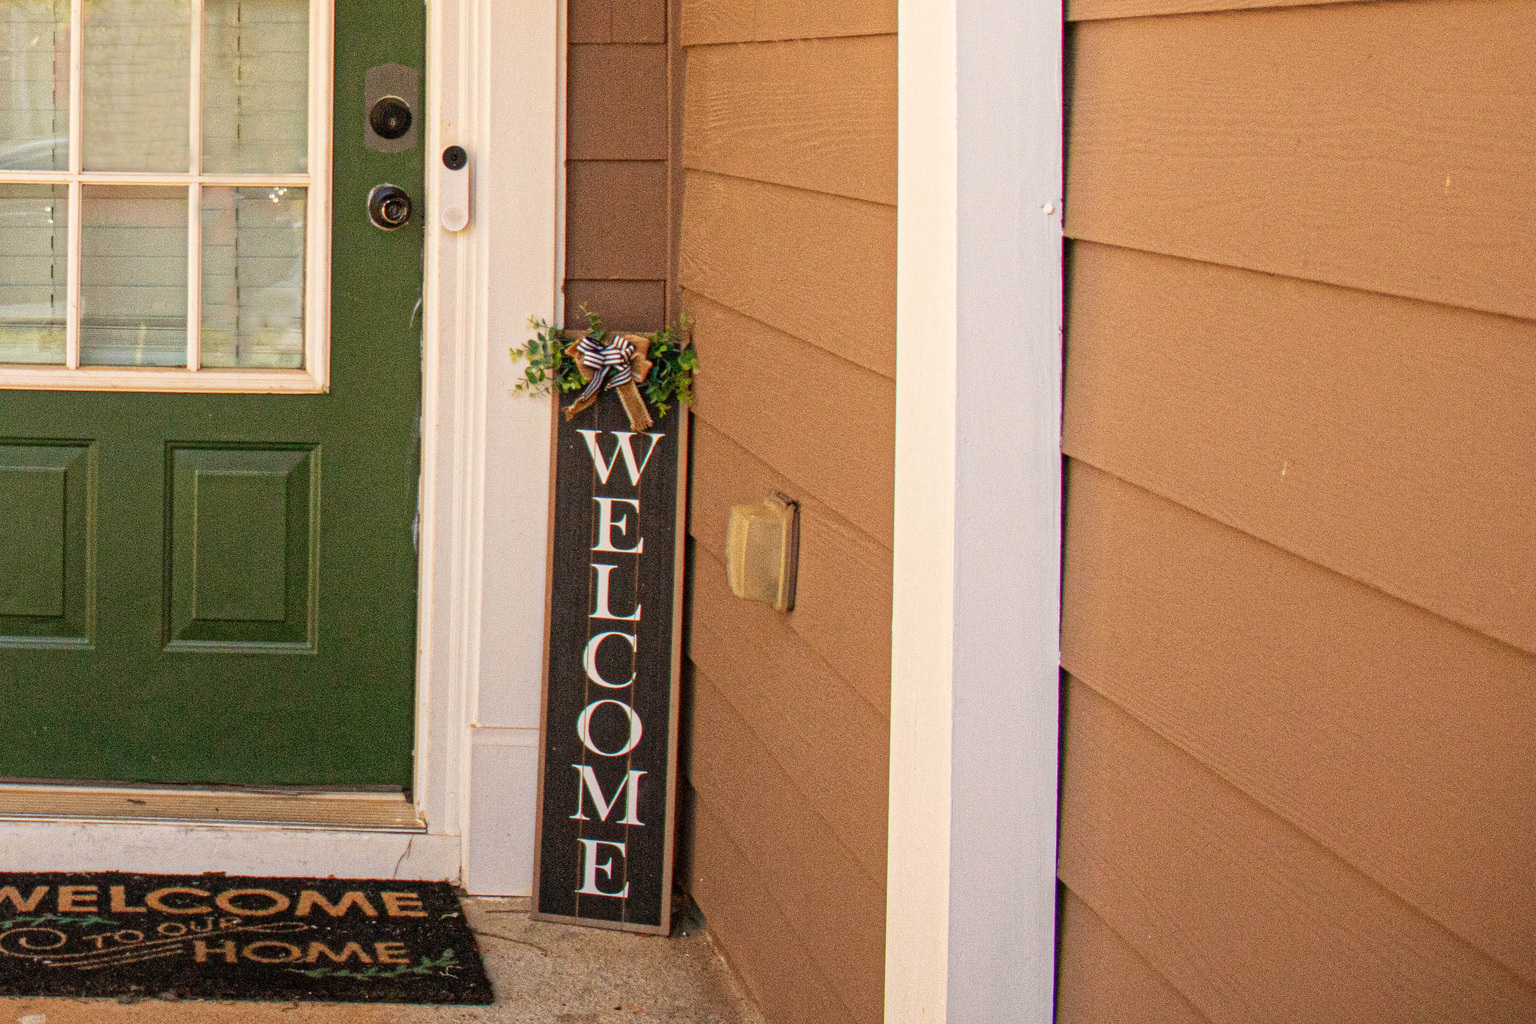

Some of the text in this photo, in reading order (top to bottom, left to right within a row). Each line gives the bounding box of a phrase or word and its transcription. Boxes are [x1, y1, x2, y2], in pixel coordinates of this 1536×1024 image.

[568, 429, 666, 900] WELCOME
[82, 916, 243, 950] TO OUR
[193, 939, 411, 966] HOME
